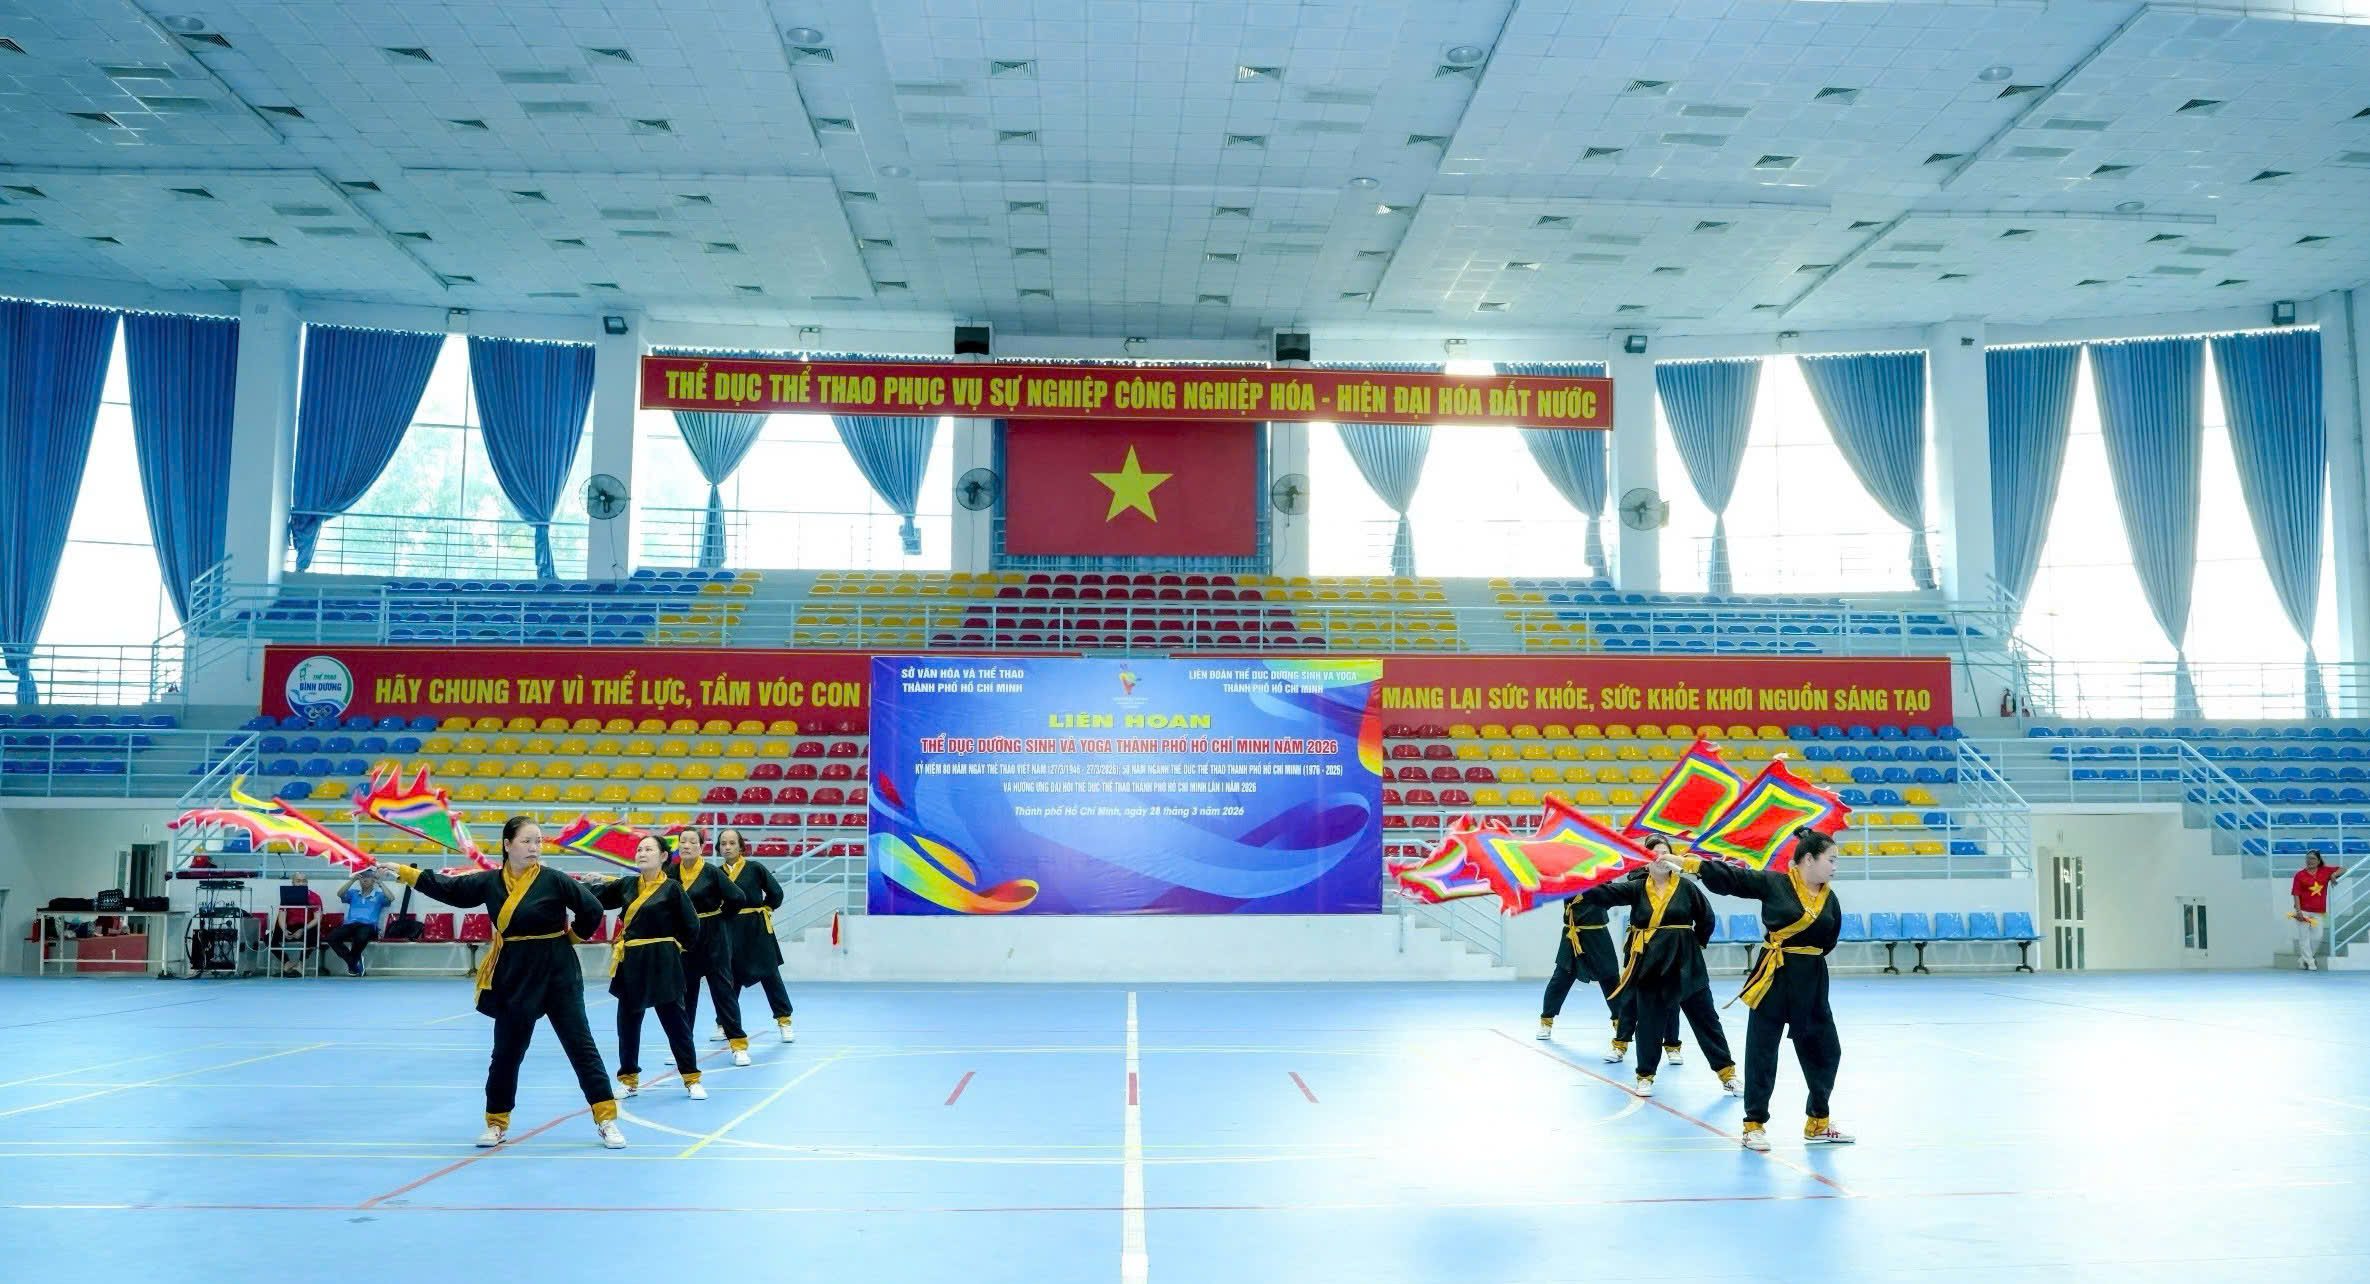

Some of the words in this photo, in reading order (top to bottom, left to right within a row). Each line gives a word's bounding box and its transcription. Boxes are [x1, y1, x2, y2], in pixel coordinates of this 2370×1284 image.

[666, 362, 708, 400] THỂ
[715, 372, 761, 406] DỤC
[770, 365, 811, 404] THỂ
[817, 375, 874, 405] THAO
[884, 376, 950, 411] PHỤC
[953, 377, 982, 411] VỤ
[989, 375, 1022, 412] SỰ
[1027, 375, 1106, 413] NGHIỆP
[1115, 376, 1175, 411] CÔNG
[1183, 378, 1263, 415] NGHIỆP
[1270, 378, 1315, 412] HÓA
[1337, 380, 1387, 418] HIỆN
[1394, 386, 1430, 420] ĐẠI
[1438, 382, 1481, 416] HÓA
[1489, 379, 1530, 418] ĐẤT
[1537, 383, 1597, 419] NƯỚC
[901, 666, 915, 678] SỞ
[917, 667, 937, 678] VĂN
[941, 667, 960, 678] HÓA
[963, 668, 976, 678] VÀ
[978, 666, 997, 678] THỂ
[999, 669, 1024, 678] THAO
[1189, 668, 1207, 679] LIÊN
[1235, 667, 1250, 679] THỂ
[1302, 671, 1320, 680] SINH
[1336, 671, 1357, 680] YOGA
[375, 674, 421, 704] HÃY
[429, 678, 510, 704] CHUNG
[517, 679, 554, 704] TAY
[562, 674, 584, 705] VÌ
[592, 670, 636, 705] THỂ
[641, 676, 692, 710] LỰC,
[700, 672, 750, 706] TẦM
[759, 676, 803, 707] VÓC
[811, 681, 860, 707] CON
[902, 681, 935, 692] THÀNH
[938, 680, 958, 692] PHỐ
[961, 681, 973, 692] HỒ
[977, 682, 993, 692] CHÍ
[996, 683, 1023, 692] MINH
[1301, 684, 1323, 693] MINH
[1382, 687, 1444, 710] MANG
[1450, 687, 1482, 714] LẠI
[1488, 682, 1529, 710] SỨC
[1535, 680, 1595, 713] KHỎE,
[1601, 683, 1641, 710] SỨC
[1647, 681, 1699, 710] KHỎE
[1706, 686, 1752, 711] KHƠI
[1759, 682, 1828, 711] NGUỒN
[1834, 684, 1887, 711] SÁNG
[1893, 689, 1930, 716] TẠO
[1048, 712, 1114, 729] LIÊN
[1125, 714, 1212, 729] HOAN
[921, 733, 946, 753] THỂ
[948, 738, 974, 756] DỤC
[978, 736, 1021, 753] DƯỠNG
[1026, 738, 1056, 753] SINH
[1060, 736, 1076, 753] VÀ
[1080, 738, 1112, 753] YOGA
[1116, 736, 1158, 753] THÀNH
[1161, 734, 1188, 753] PHỐ
[1191, 735, 1209, 753] HỒ
[1211, 736, 1233, 753] CHÍ
[1237, 739, 1270, 754] MINH
[1274, 736, 1303, 754] NĂM
[1307, 739, 1338, 754] 2026
[943, 764, 951, 774] 80
[1285, 764, 1301, 775] MINH
[1303, 765, 1320, 776] (1976
[1326, 765, 1343, 776] 2026)
[1241, 782, 1257, 792] 2026
[1015, 806, 1042, 816] Thành
[1044, 805, 1064, 818] phố
[1080, 806, 1095, 816] Chí
[1150, 807, 1161, 816] 28
[1163, 807, 1189, 818] tháng
[1192, 807, 1198, 816] 3
[1200, 807, 1220, 816] năm
[1222, 807, 1244, 816] 2026
